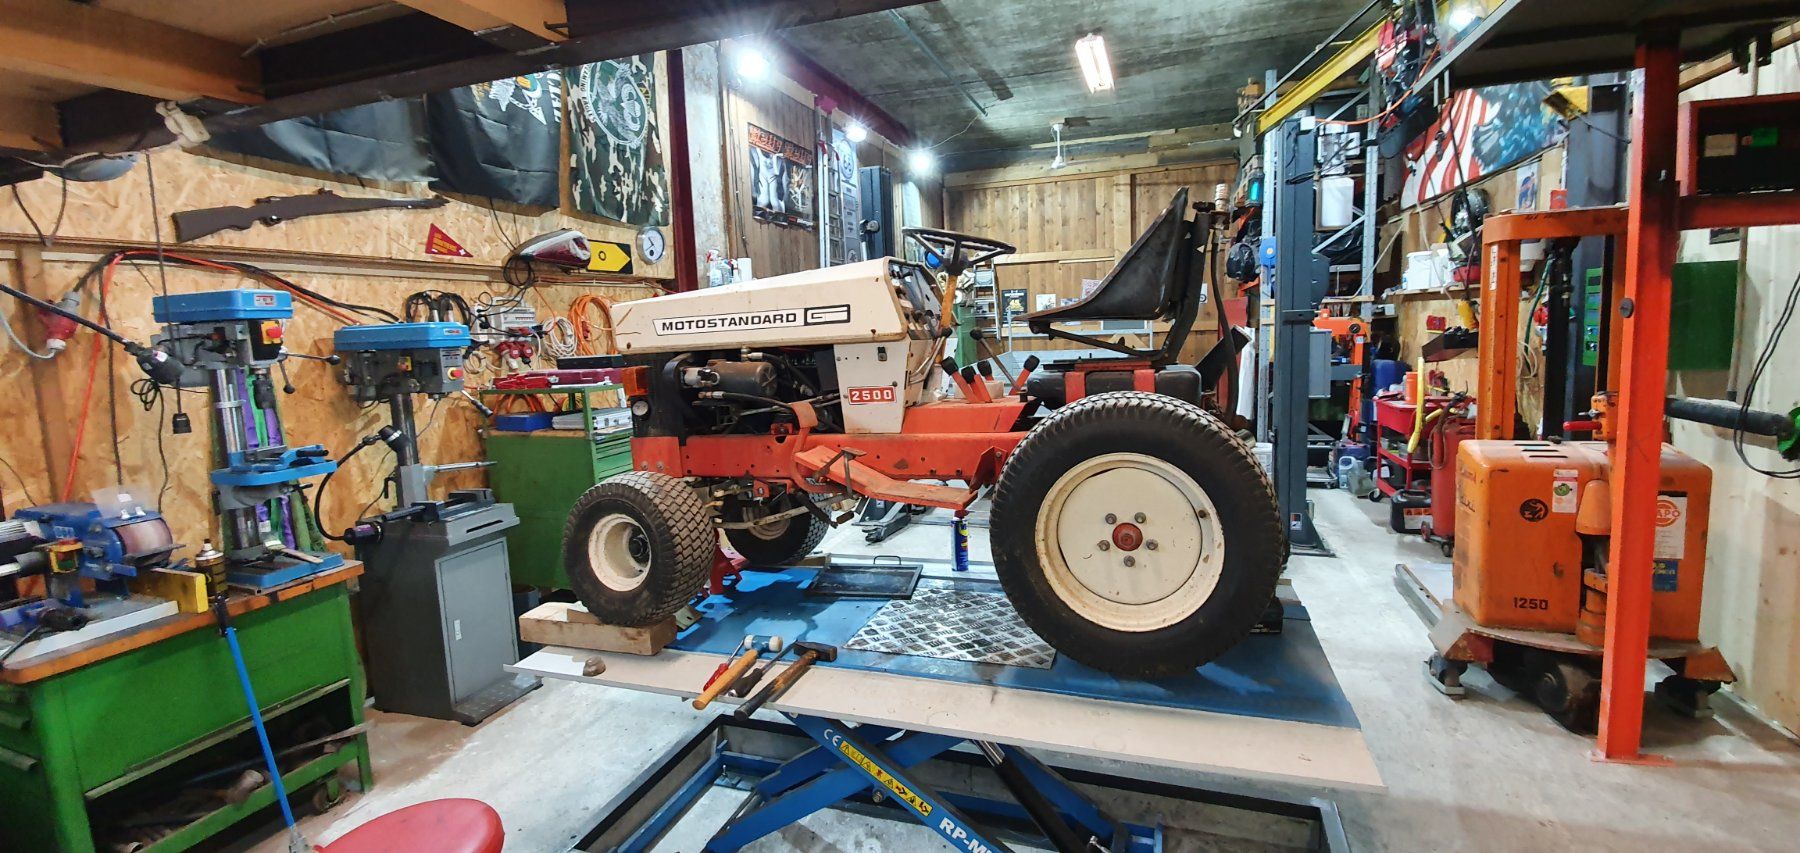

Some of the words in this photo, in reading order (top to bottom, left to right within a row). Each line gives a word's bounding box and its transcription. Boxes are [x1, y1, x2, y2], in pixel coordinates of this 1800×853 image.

[662, 312, 797, 331] MOTOSTANDARD
[851, 390, 892, 401] 2500
[1513, 597, 1549, 610] 1250
[938, 817, 993, 853] RP-M
